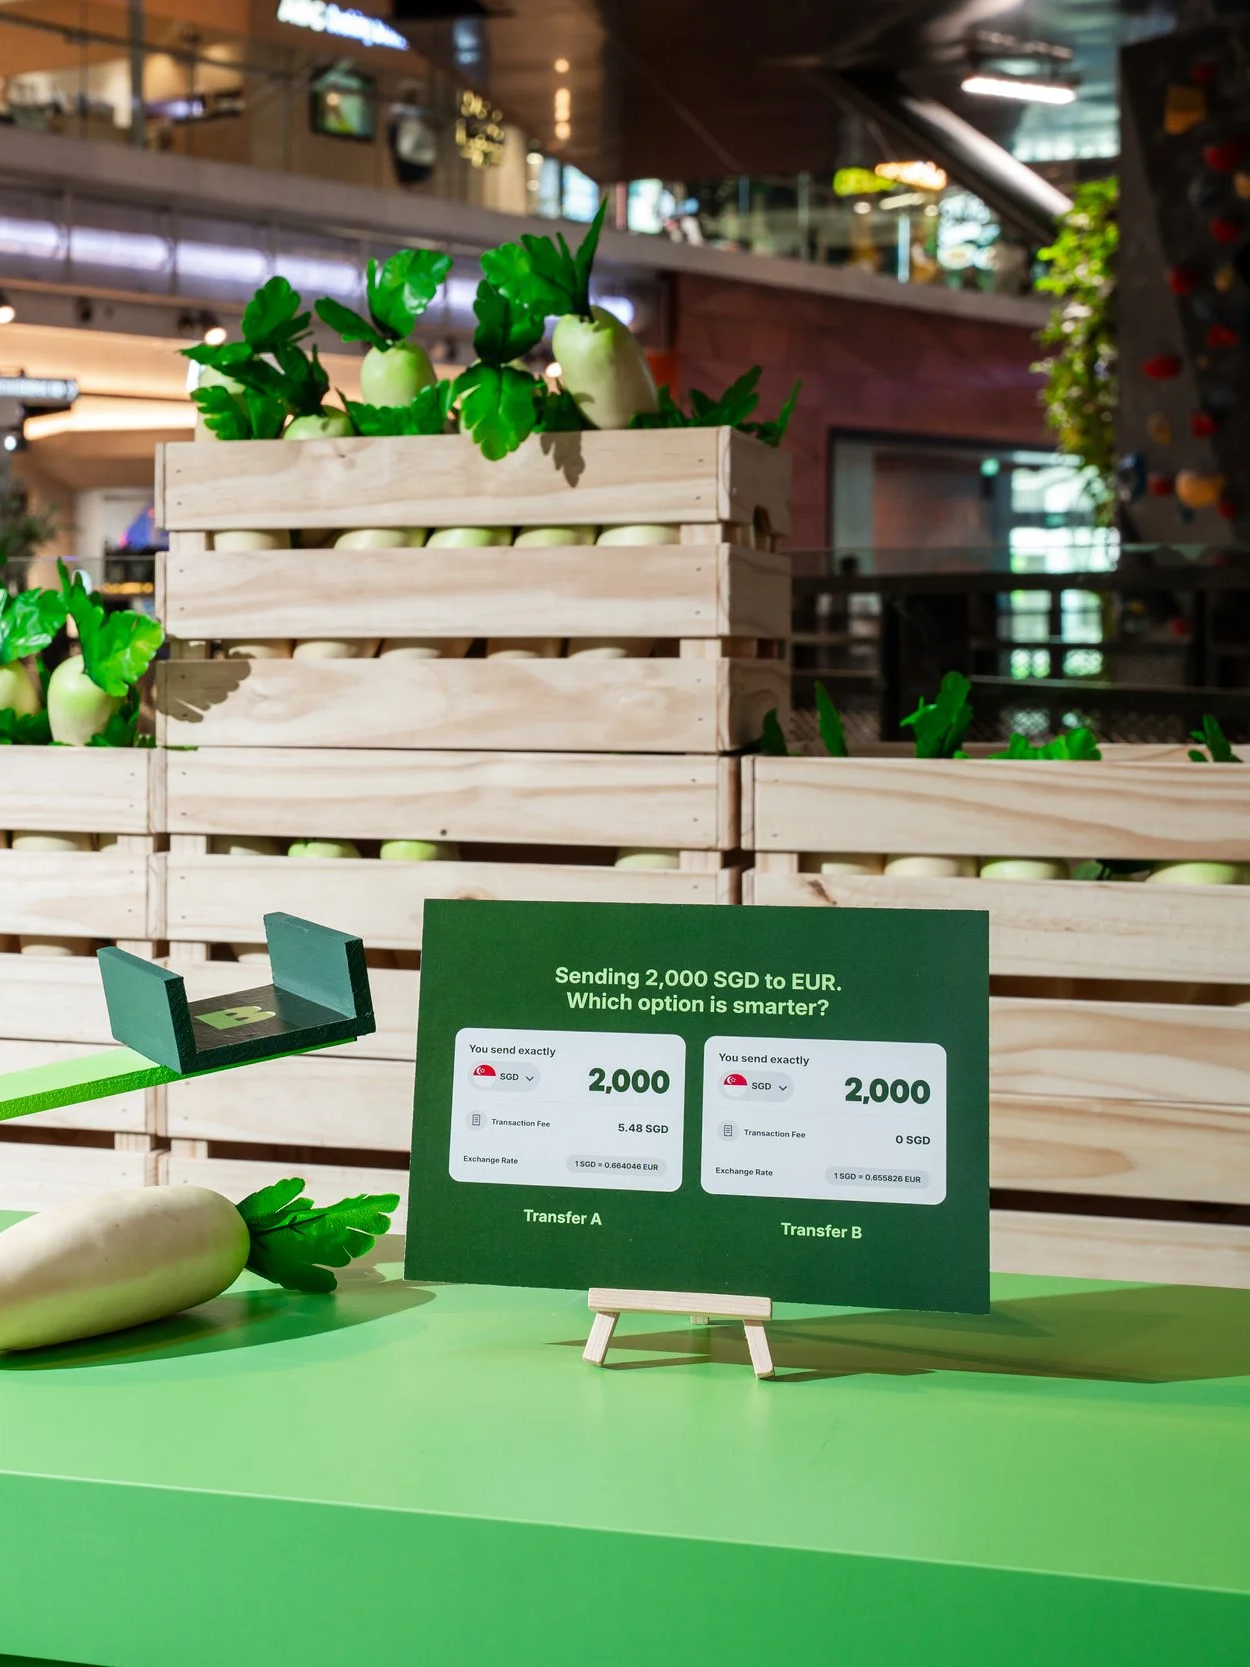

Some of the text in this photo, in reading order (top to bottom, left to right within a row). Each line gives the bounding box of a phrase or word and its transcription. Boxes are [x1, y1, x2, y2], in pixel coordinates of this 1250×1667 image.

[555, 967, 842, 991] Sending 2,000 SGD to EUR.
[566, 992, 830, 1016] Which option is smarter?
[194, 1005, 276, 1030] B
[469, 1044, 556, 1058] You send exactly
[719, 1052, 810, 1067] You send exactly
[499, 1067, 670, 1094] SGD 2,000
[751, 1077, 931, 1105] SGD 2,000
[491, 1118, 551, 1128] Transaction Fee
[618, 1123, 669, 1134] 5.48 SGD
[744, 1128, 806, 1139] Transaction Fee
[895, 1135, 931, 1145] 0 SGD
[463, 1155, 519, 1165] Exchange Rate
[579, 1160, 596, 1168] SGD
[604, 1161, 642, 1170] 0.664046
[643, 1163, 659, 1171] EUR
[715, 1167, 773, 1177] Exchange Rate
[839, 1172, 857, 1180] SGD
[865, 1174, 903, 1183] 0.655826
[904, 1175, 921, 1184] EUR
[523, 1209, 603, 1226] Transfer A
[781, 1222, 862, 1239] Transfer B
